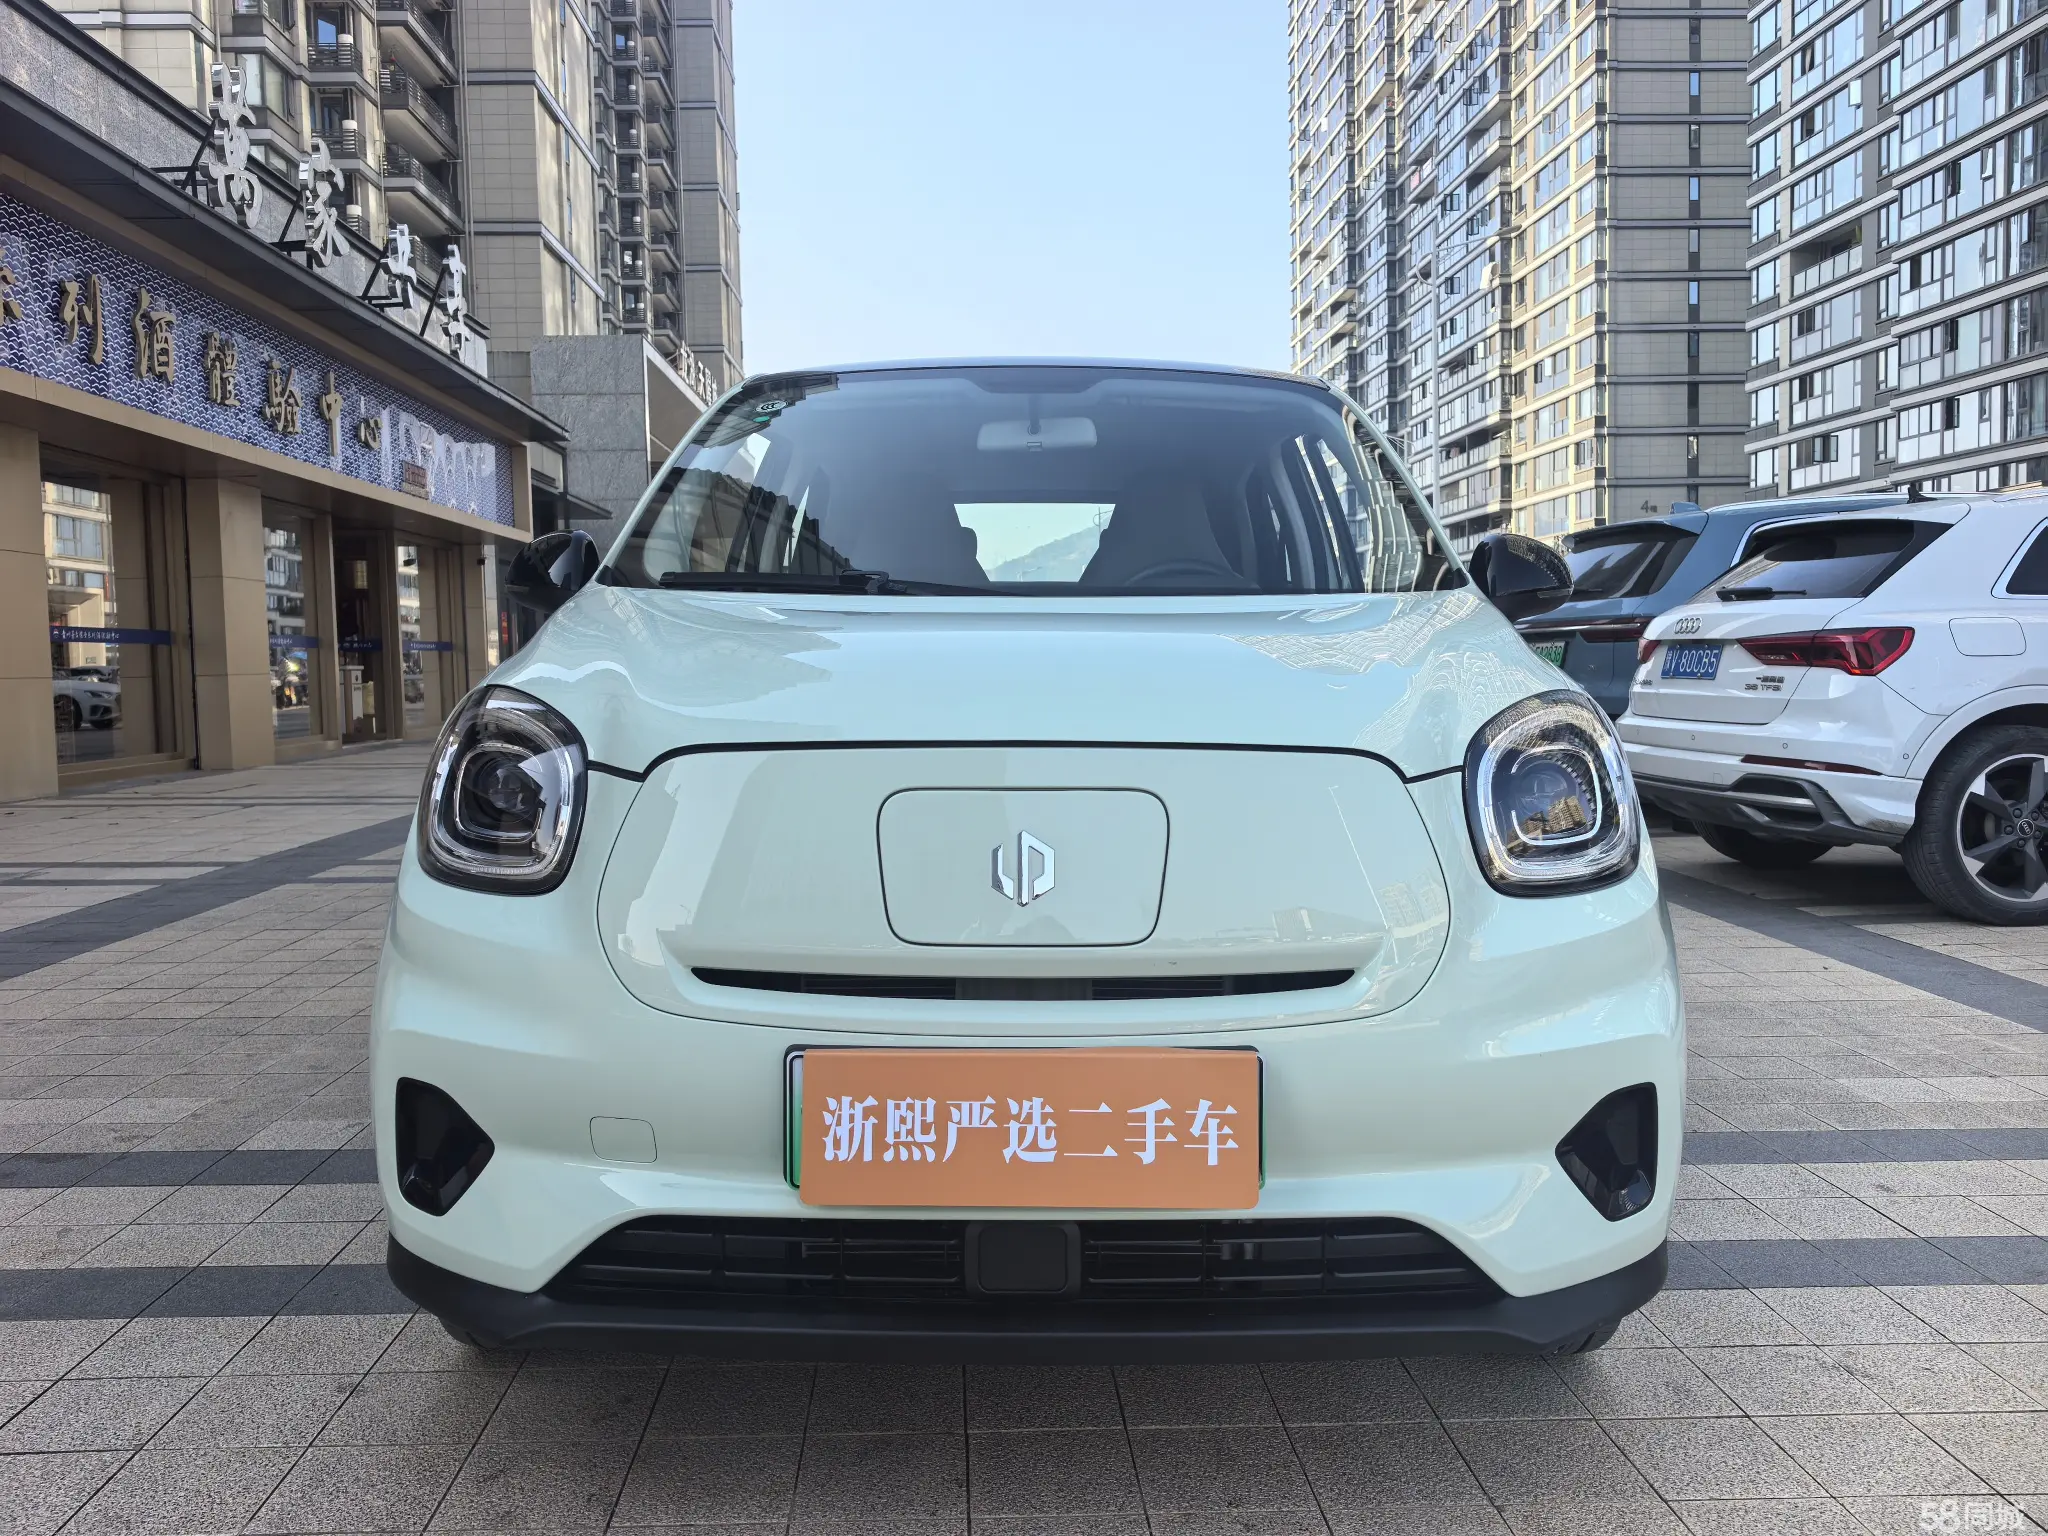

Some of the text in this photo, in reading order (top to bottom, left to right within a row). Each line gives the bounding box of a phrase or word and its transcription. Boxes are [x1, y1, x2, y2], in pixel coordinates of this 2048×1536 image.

[822, 1095, 1239, 1166] 浙熙严选二手车
